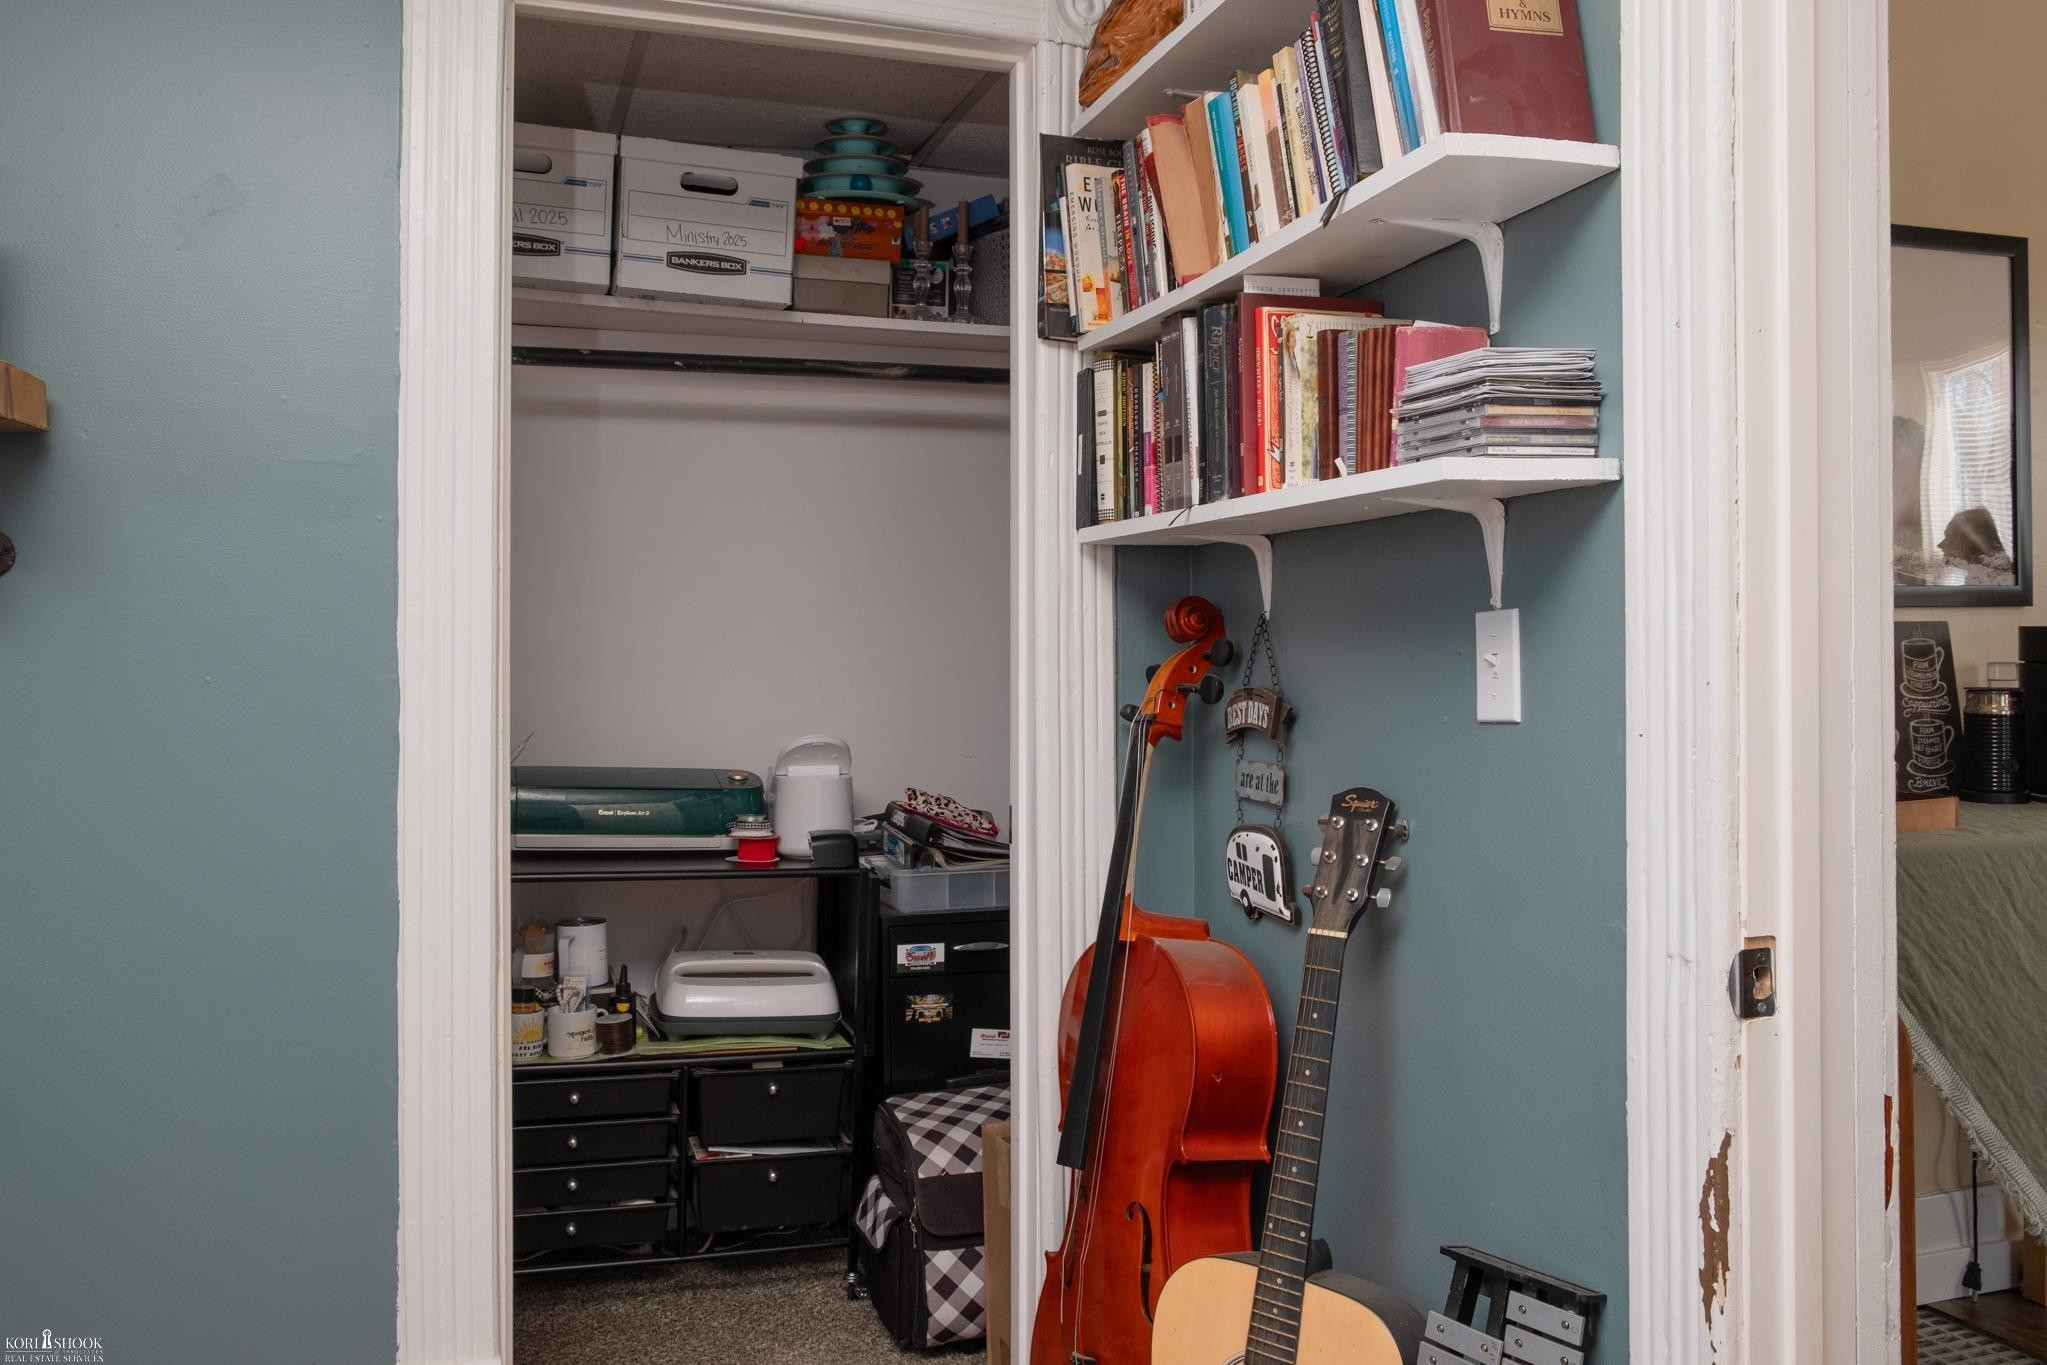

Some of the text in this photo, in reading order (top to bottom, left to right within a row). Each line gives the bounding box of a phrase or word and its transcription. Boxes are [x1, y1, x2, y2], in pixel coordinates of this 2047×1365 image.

[1519, 0, 1528, 8] &
[1499, 8, 1551, 23] HYMNS
[1229, 77, 1241, 122] DOCTRINE
[1236, 136, 1248, 172] DANCES
[529, 207, 569, 226] 2025
[1069, 192, 1078, 239] EMERGING
[1121, 198, 1129, 227] BRAIN
[666, 223, 748, 247] Ministry 2025
[1124, 229, 1130, 240] IN
[533, 242, 556, 251] BOX
[671, 255, 743, 271] BANKERS BOX
[1913, 661, 1929, 669] FOAM
[1902, 696, 1949, 712] Cappuccino
[1227, 701, 1269, 730] BEST DAYS
[1240, 771, 1279, 794] are at the
[1341, 794, 1378, 812] Squier
[1227, 857, 1264, 894] CAMPER
